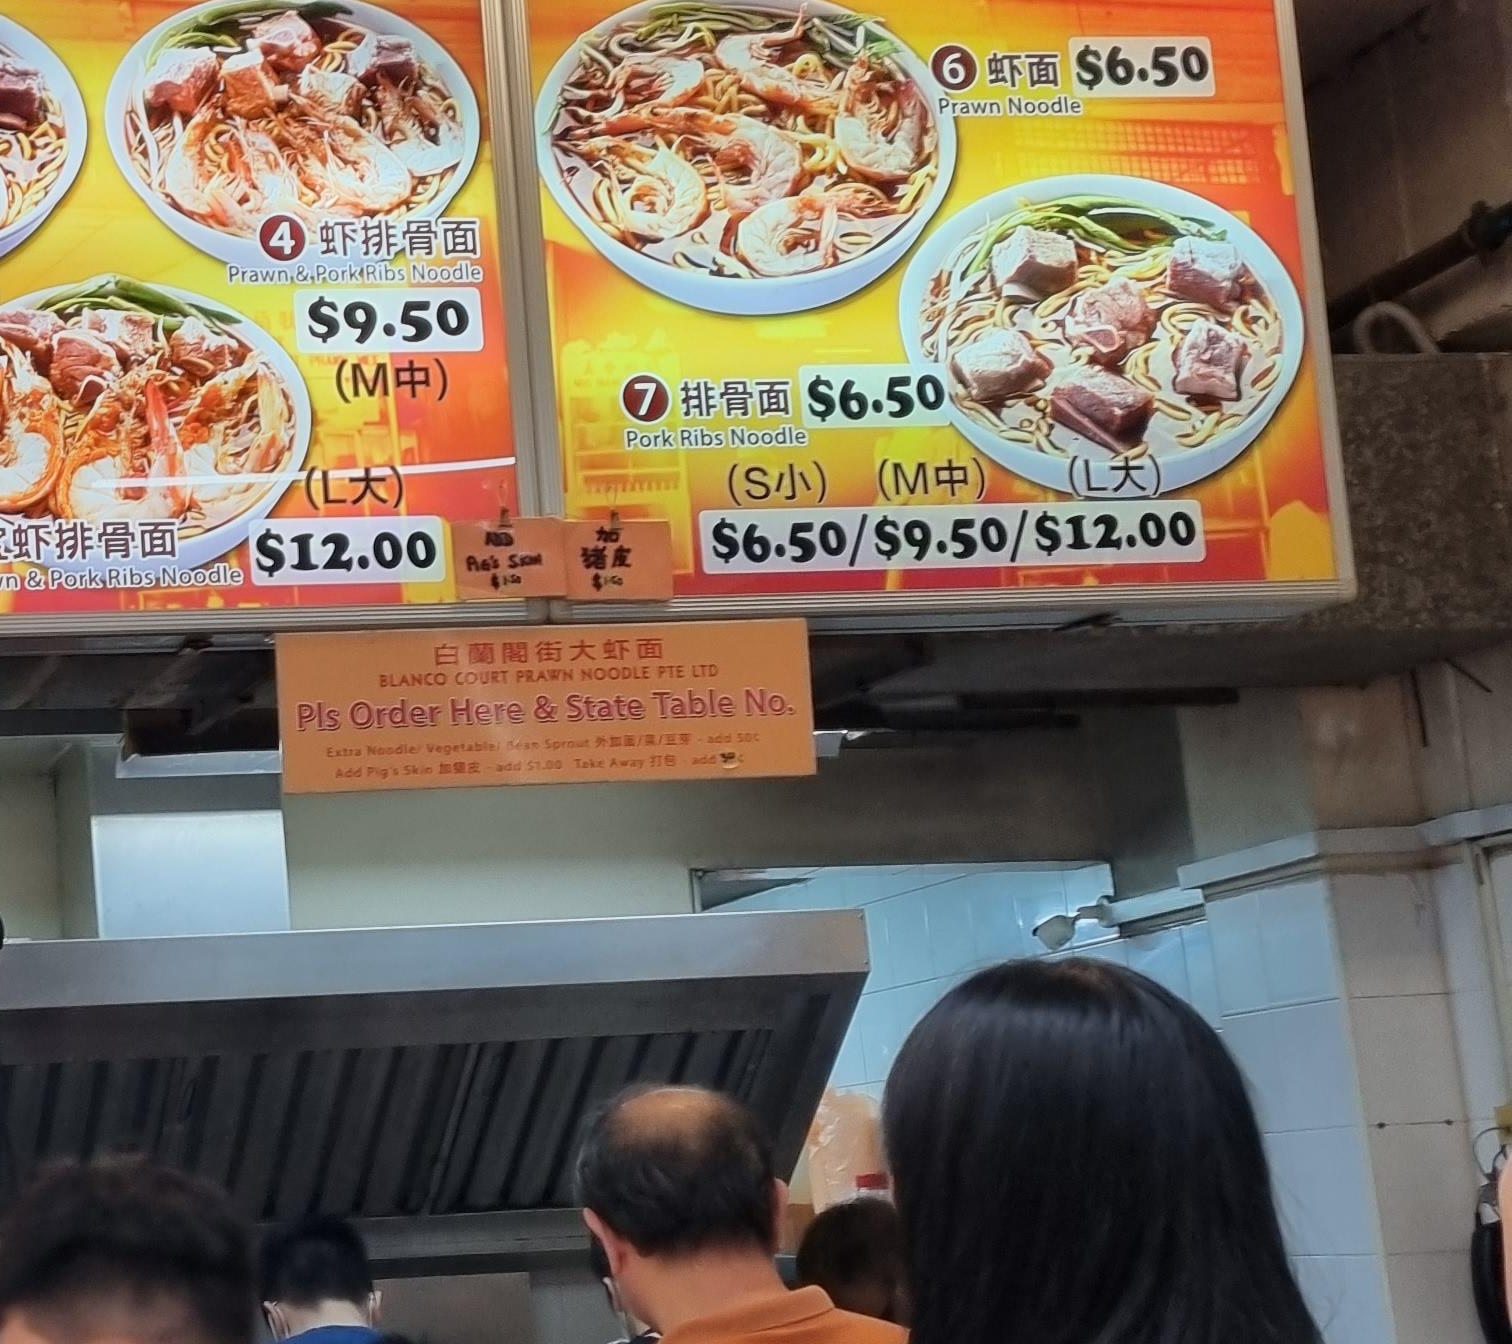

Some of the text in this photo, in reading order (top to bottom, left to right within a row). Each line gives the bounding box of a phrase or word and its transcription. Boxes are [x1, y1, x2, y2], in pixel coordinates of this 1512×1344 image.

[987, 53, 1059, 87] 虾面
[1076, 45, 1209, 90] $6.50
[938, 95, 1082, 115] Prawn Noodle
[320, 220, 478, 256] 虾排骨面
[229, 263, 481, 283] Prawn & Pork Ribs Noodle
[308, 296, 469, 344] $9.50
[335, 358, 448, 404] (M中)
[680, 381, 791, 417] 排骨面
[807, 375, 946, 422] $6.50
[626, 427, 807, 448] Pork Ribs Noodle
[595, 526, 620, 543] 加
[255, 529, 437, 577] $12.00
[27, 570, 43, 588] &
[51, 569, 103, 587] Pork
[108, 568, 155, 586] Ribs
[160, 566, 242, 586] Noodle
[380, 664, 719, 688] BLANCO COURT PRAWN NOODLE PTE LTD
[297, 687, 796, 731] Pls Order Here & State Table No.
[326, 746, 362, 758] Extra
[707, 733, 731, 744] add
[336, 767, 362, 778] Add
[403, 764, 433, 775] Skin
[495, 760, 522, 772] add
[609, 756, 644, 770] Away
